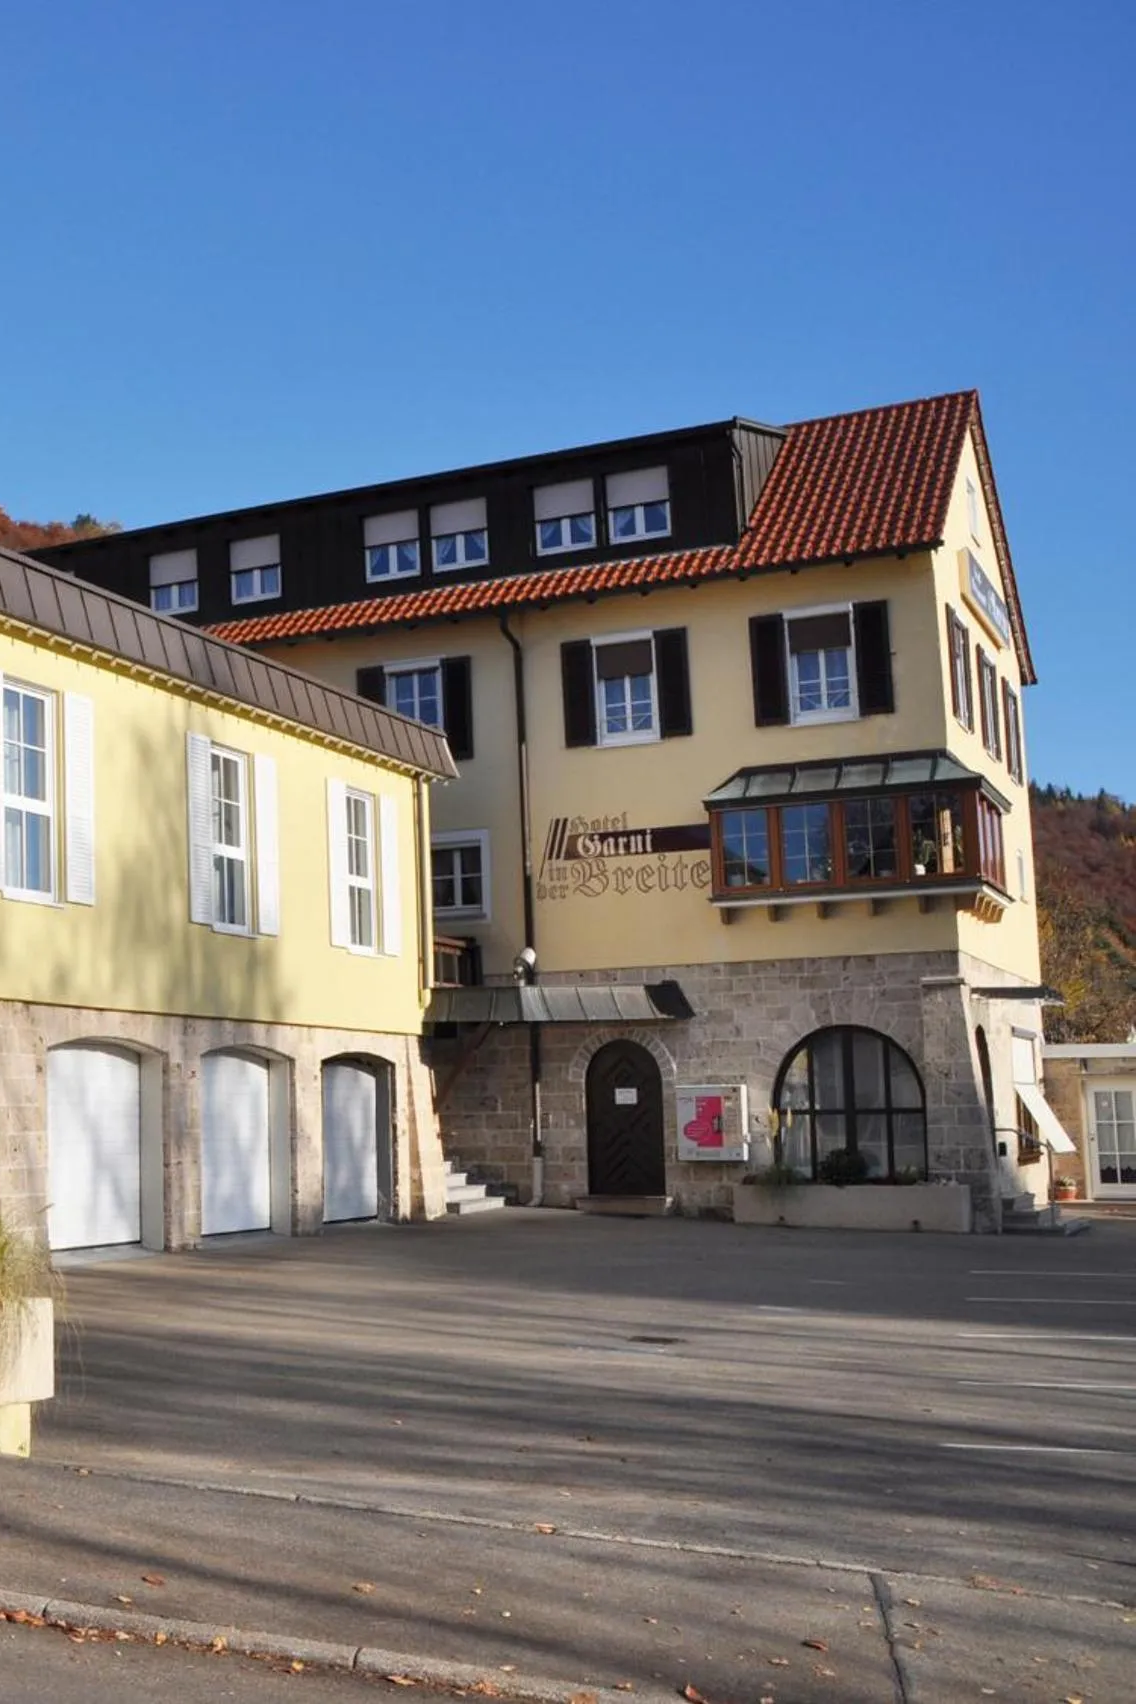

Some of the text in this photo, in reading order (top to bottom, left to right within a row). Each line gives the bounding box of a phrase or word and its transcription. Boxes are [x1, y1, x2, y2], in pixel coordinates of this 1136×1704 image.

[569, 812, 628, 833] Hotel
[577, 829, 653, 857] Garni
[548, 863, 568, 881] in
[571, 854, 712, 898] Breite
[536, 882, 569, 901] der
